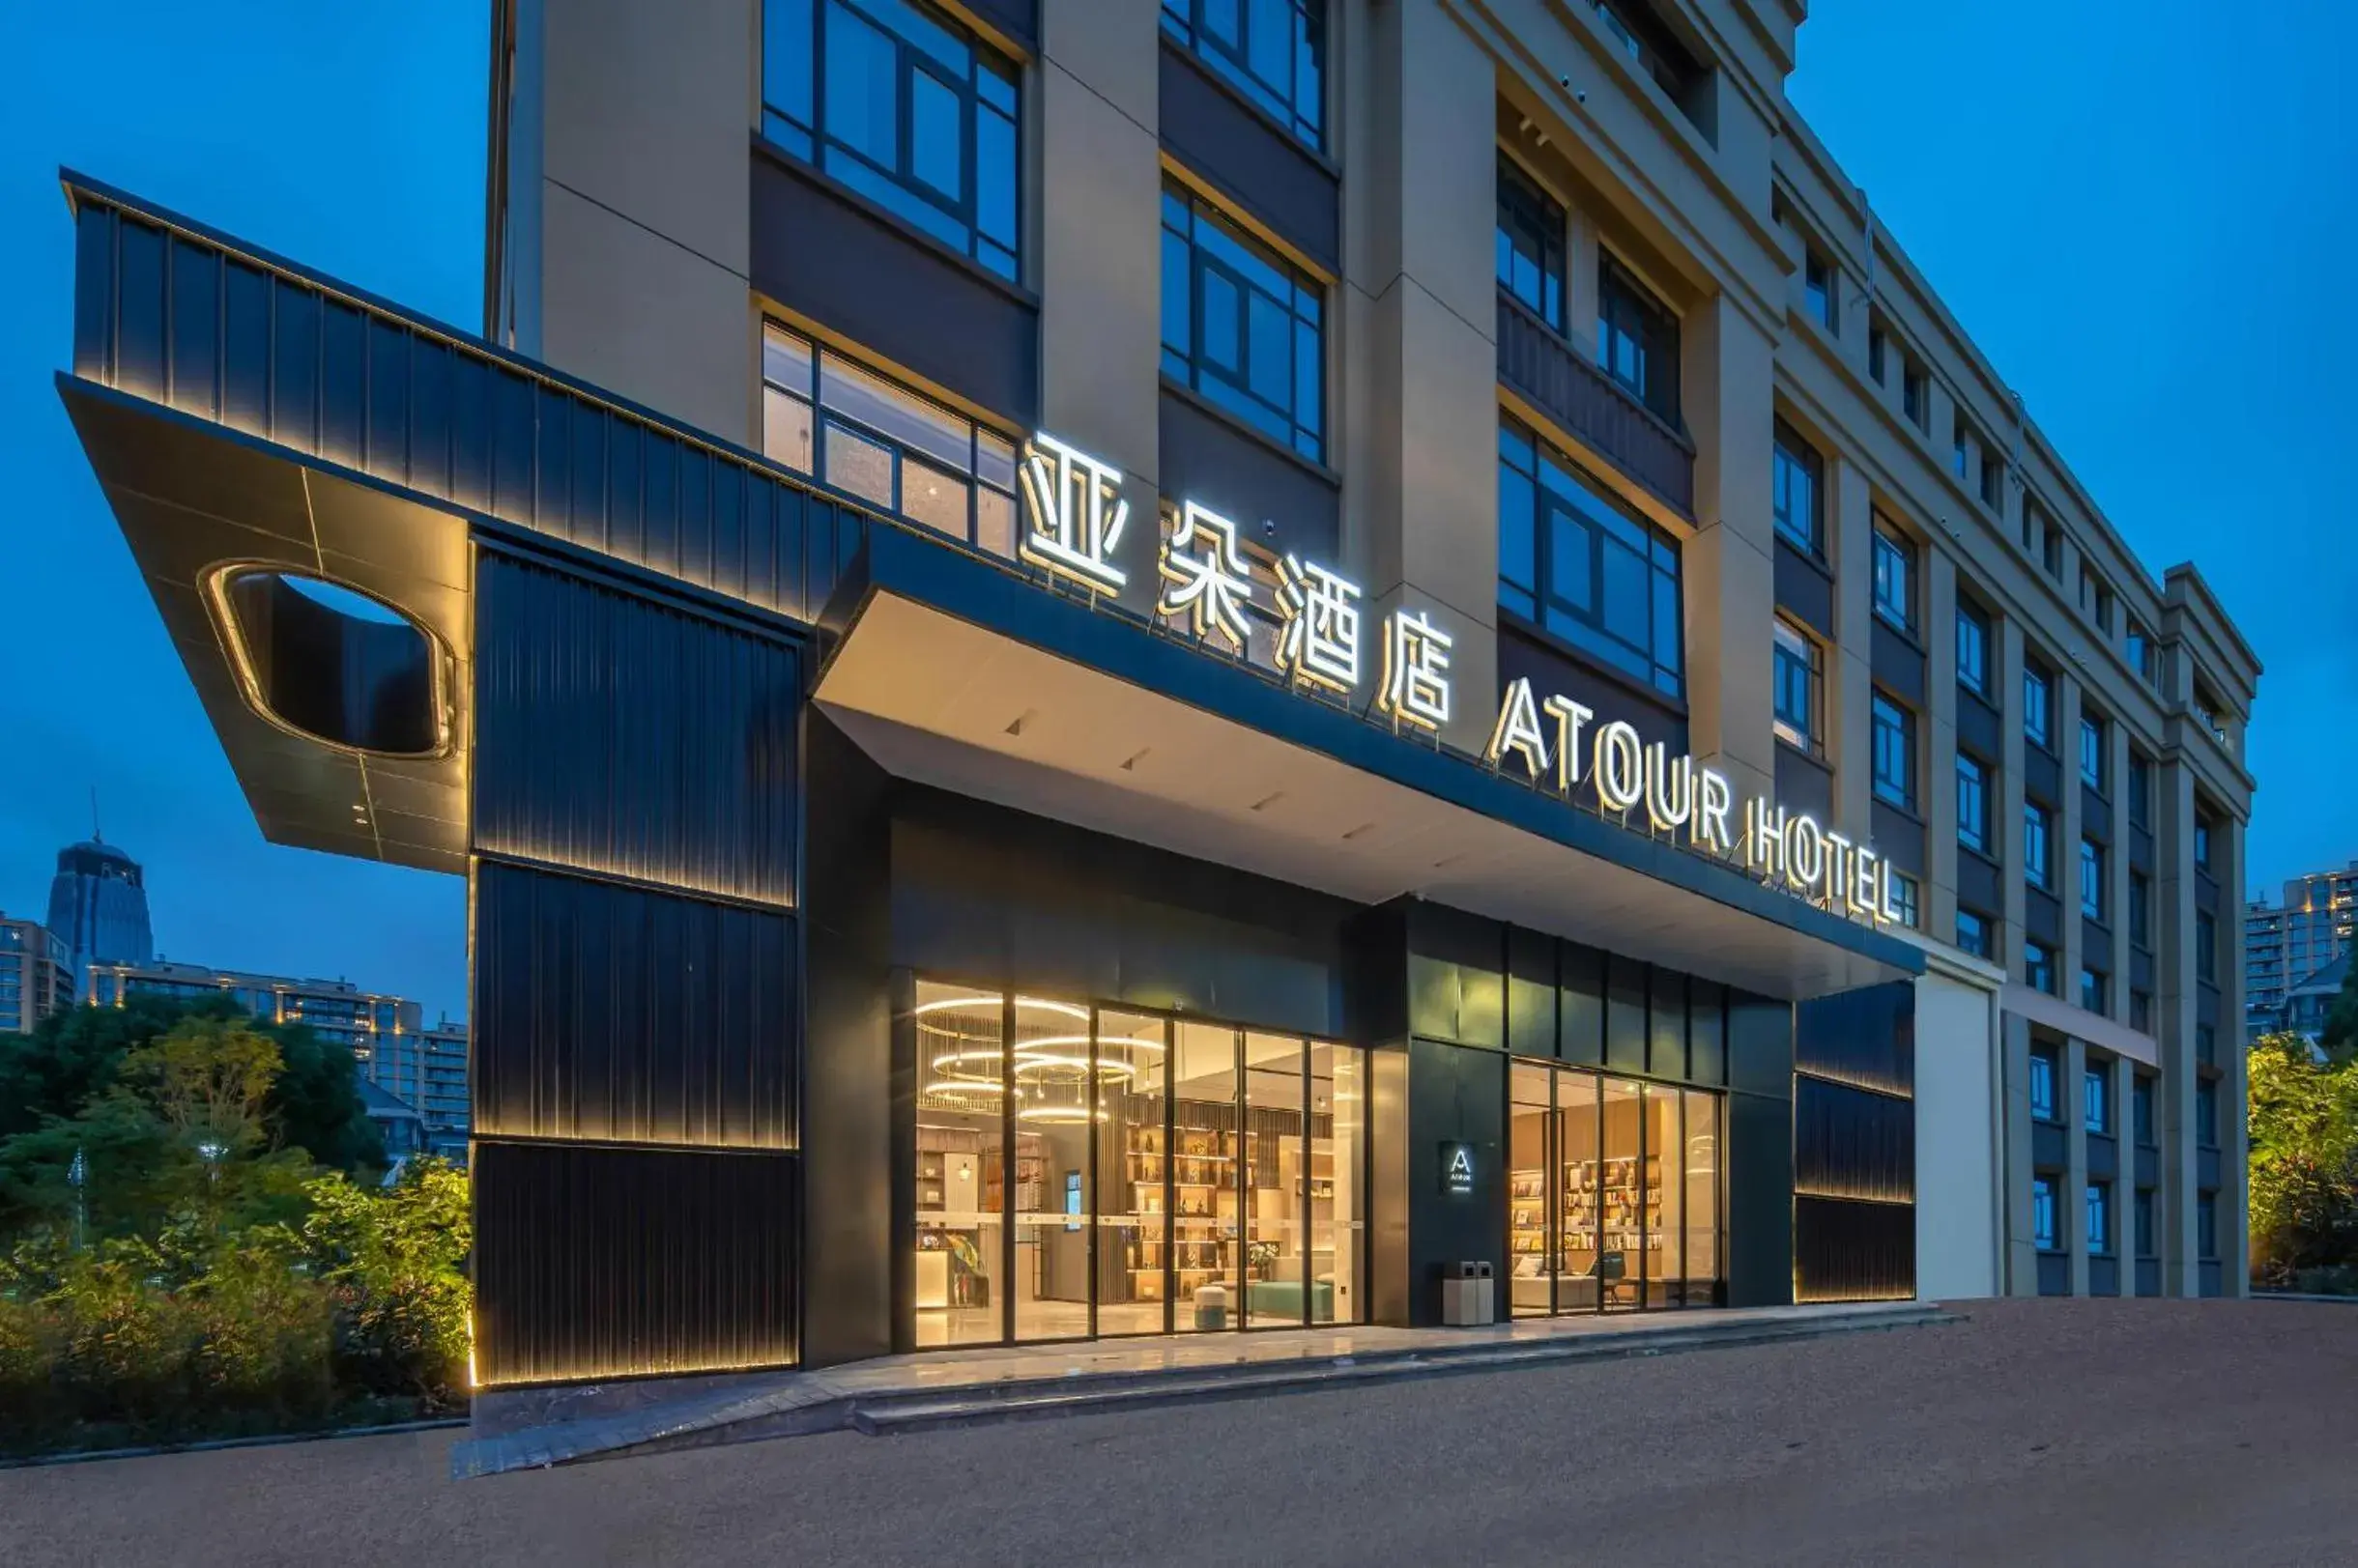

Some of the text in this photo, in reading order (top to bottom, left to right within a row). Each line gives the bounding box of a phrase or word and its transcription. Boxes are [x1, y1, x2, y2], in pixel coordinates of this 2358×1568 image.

[1021, 432, 1452, 728] 亚朵酒店
[1490, 676, 1902, 924] ATOUR HOTEL
